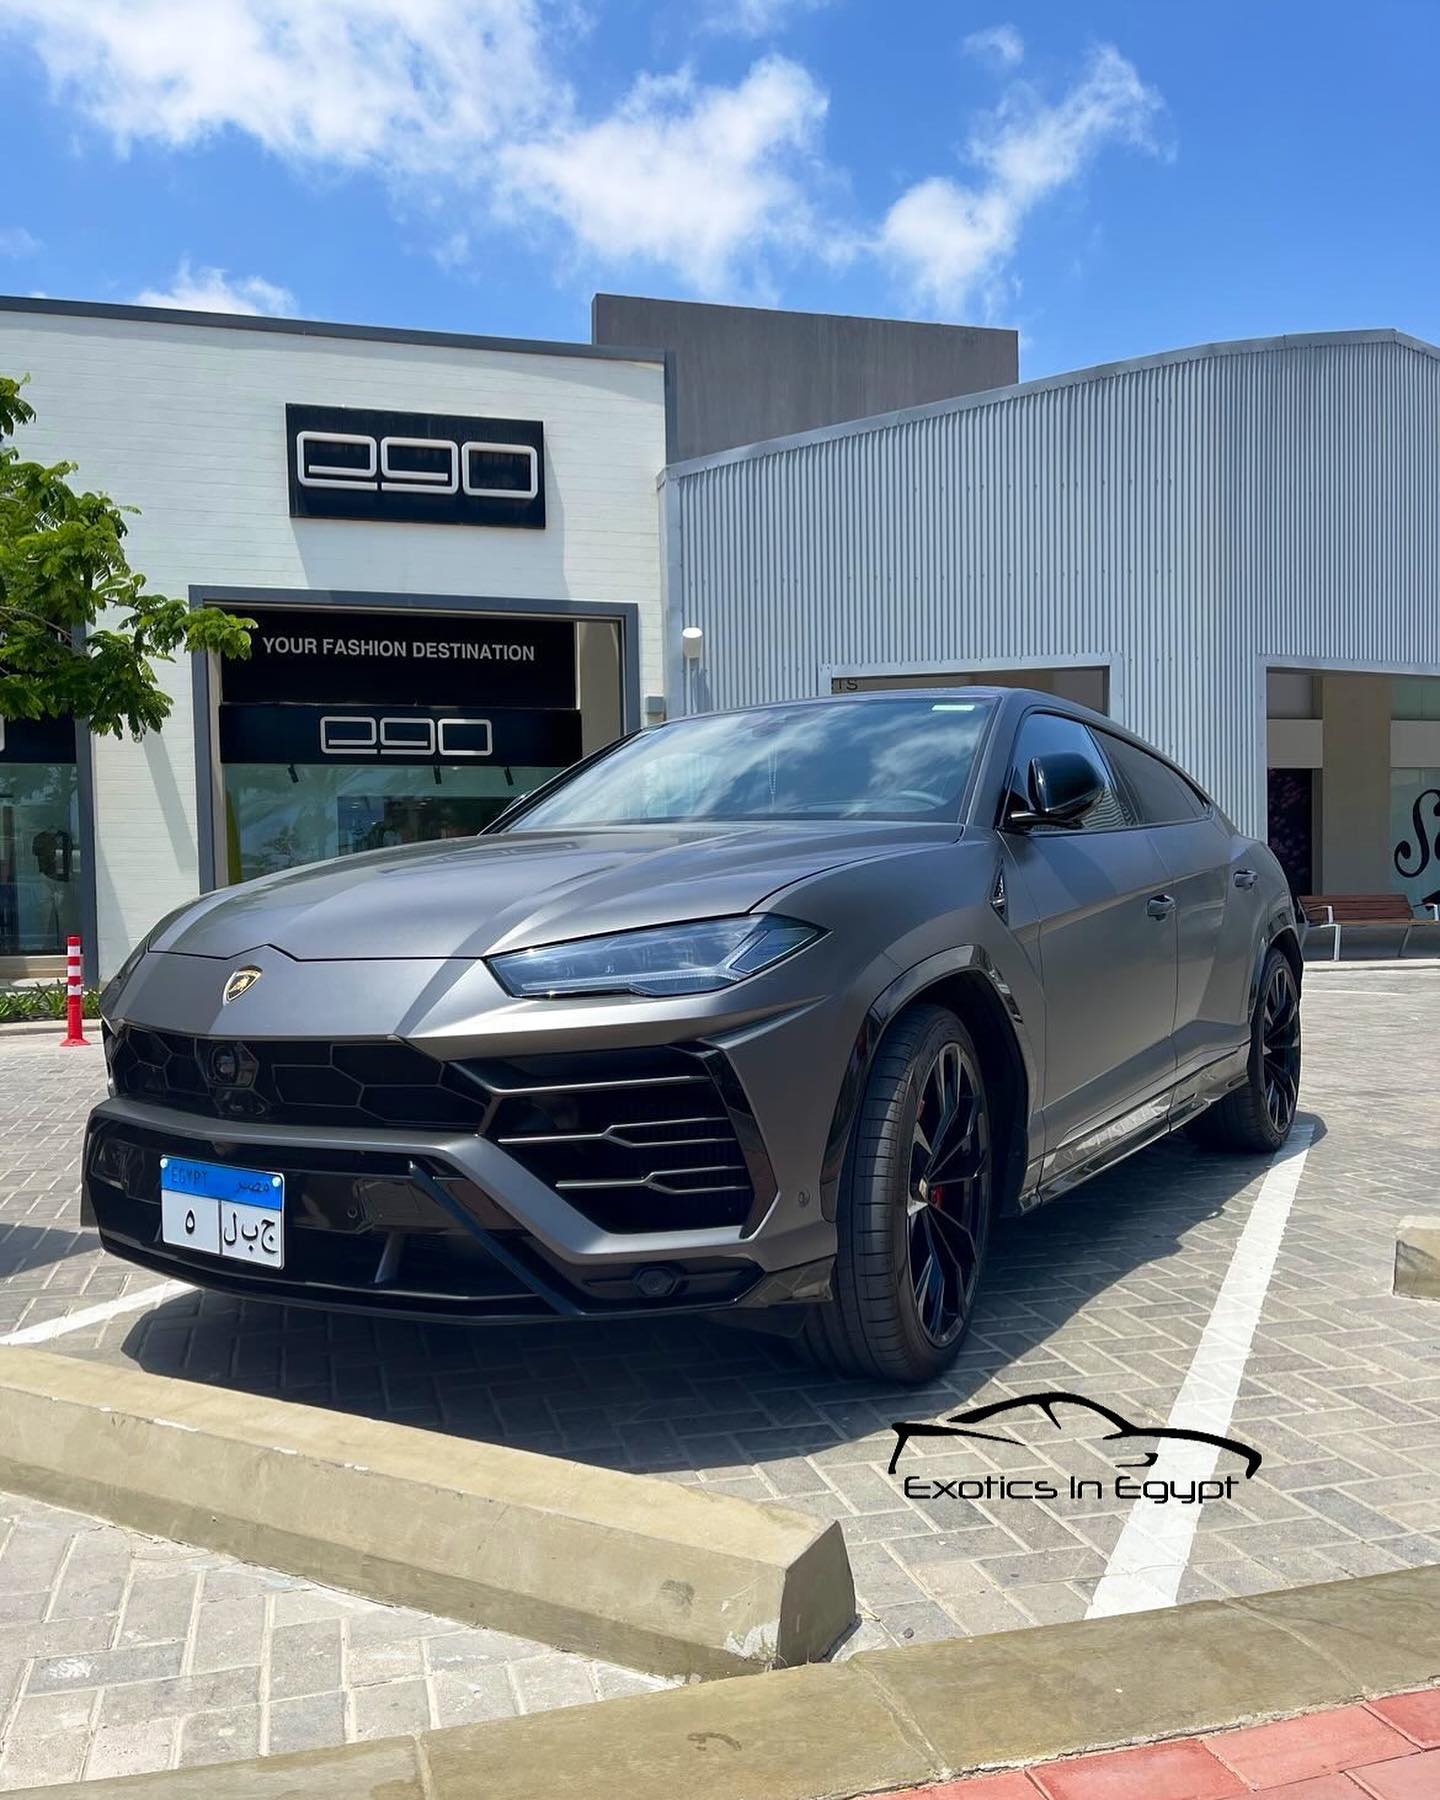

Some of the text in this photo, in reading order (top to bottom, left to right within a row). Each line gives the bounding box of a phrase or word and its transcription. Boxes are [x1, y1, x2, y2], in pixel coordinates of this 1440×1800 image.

[296, 430, 538, 499] ego
[262, 637, 536, 661] YOUR FASHION DESTINATION
[319, 715, 493, 756] ego
[1394, 788, 1440, 878] S
[171, 1166, 208, 1188] EGYPT
[234, 1180, 270, 1194] مصر
